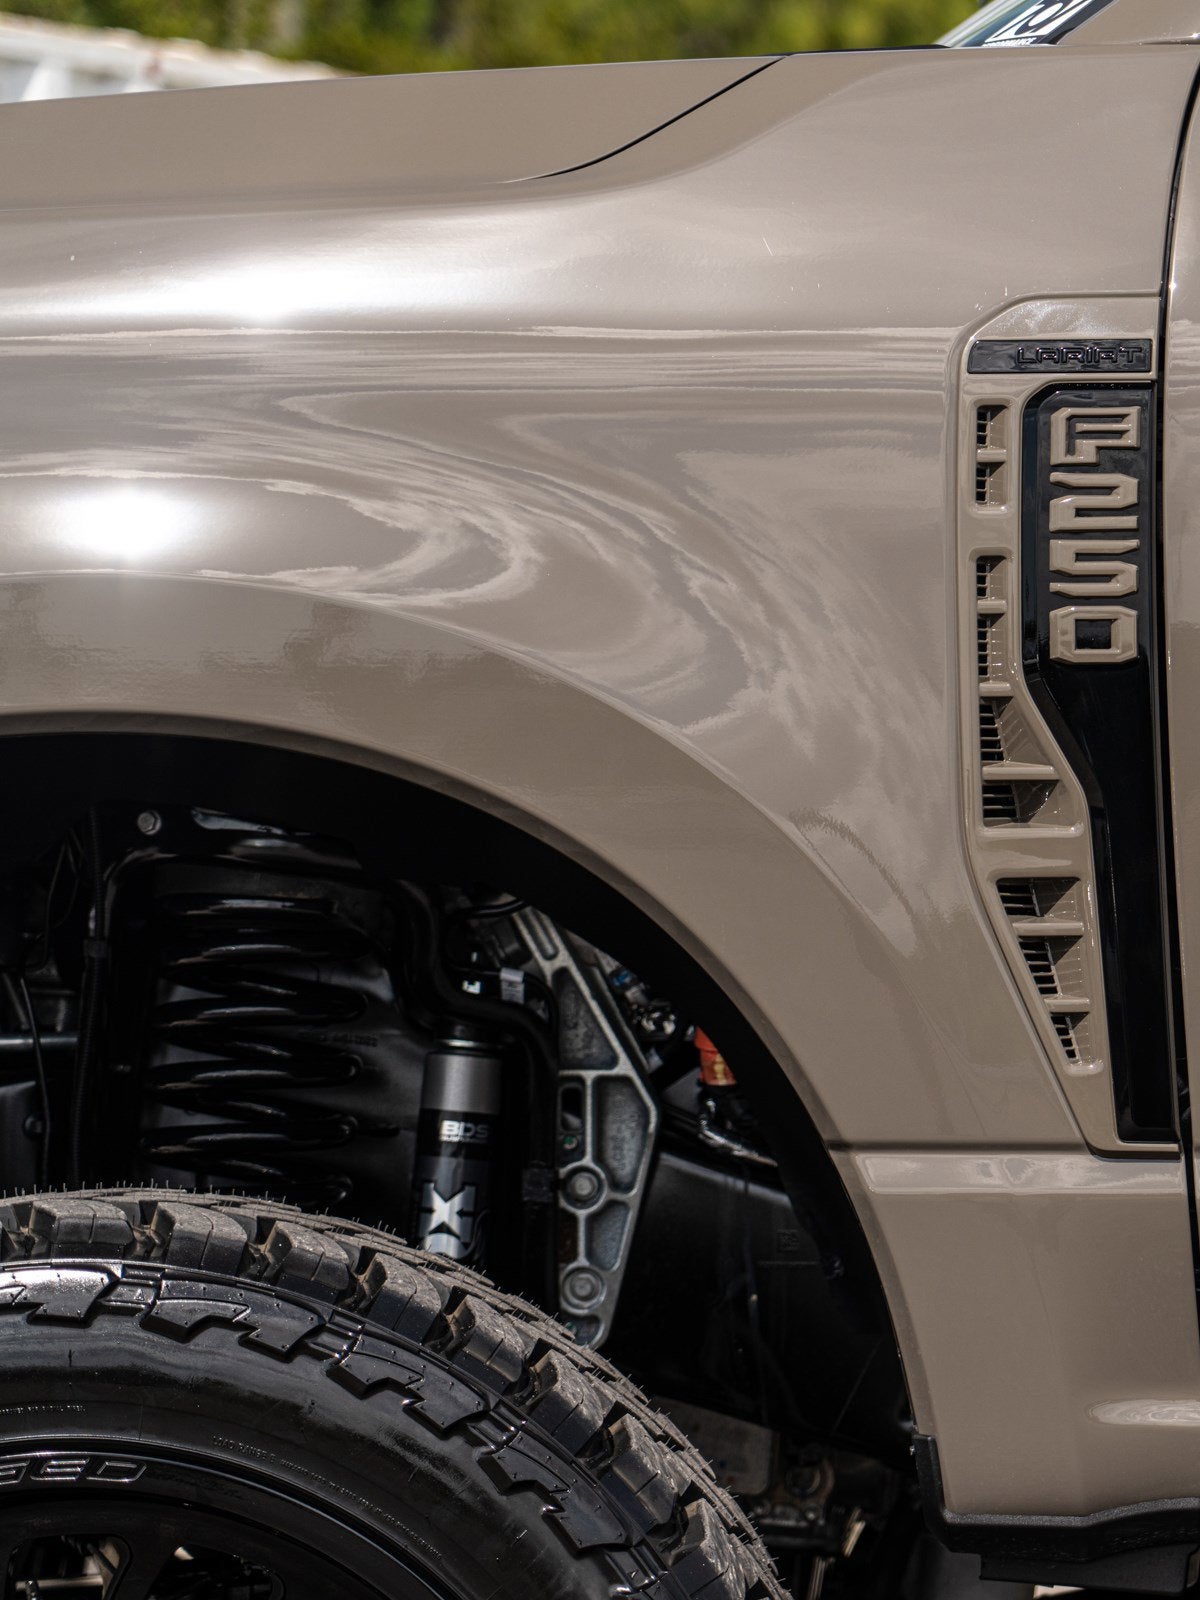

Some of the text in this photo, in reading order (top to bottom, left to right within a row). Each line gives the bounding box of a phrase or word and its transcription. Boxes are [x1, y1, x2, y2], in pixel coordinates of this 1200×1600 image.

[1017, 346, 1143, 365] LARIAT
[1048, 405, 1141, 664] F250
[440, 1119, 491, 1138] BDS
